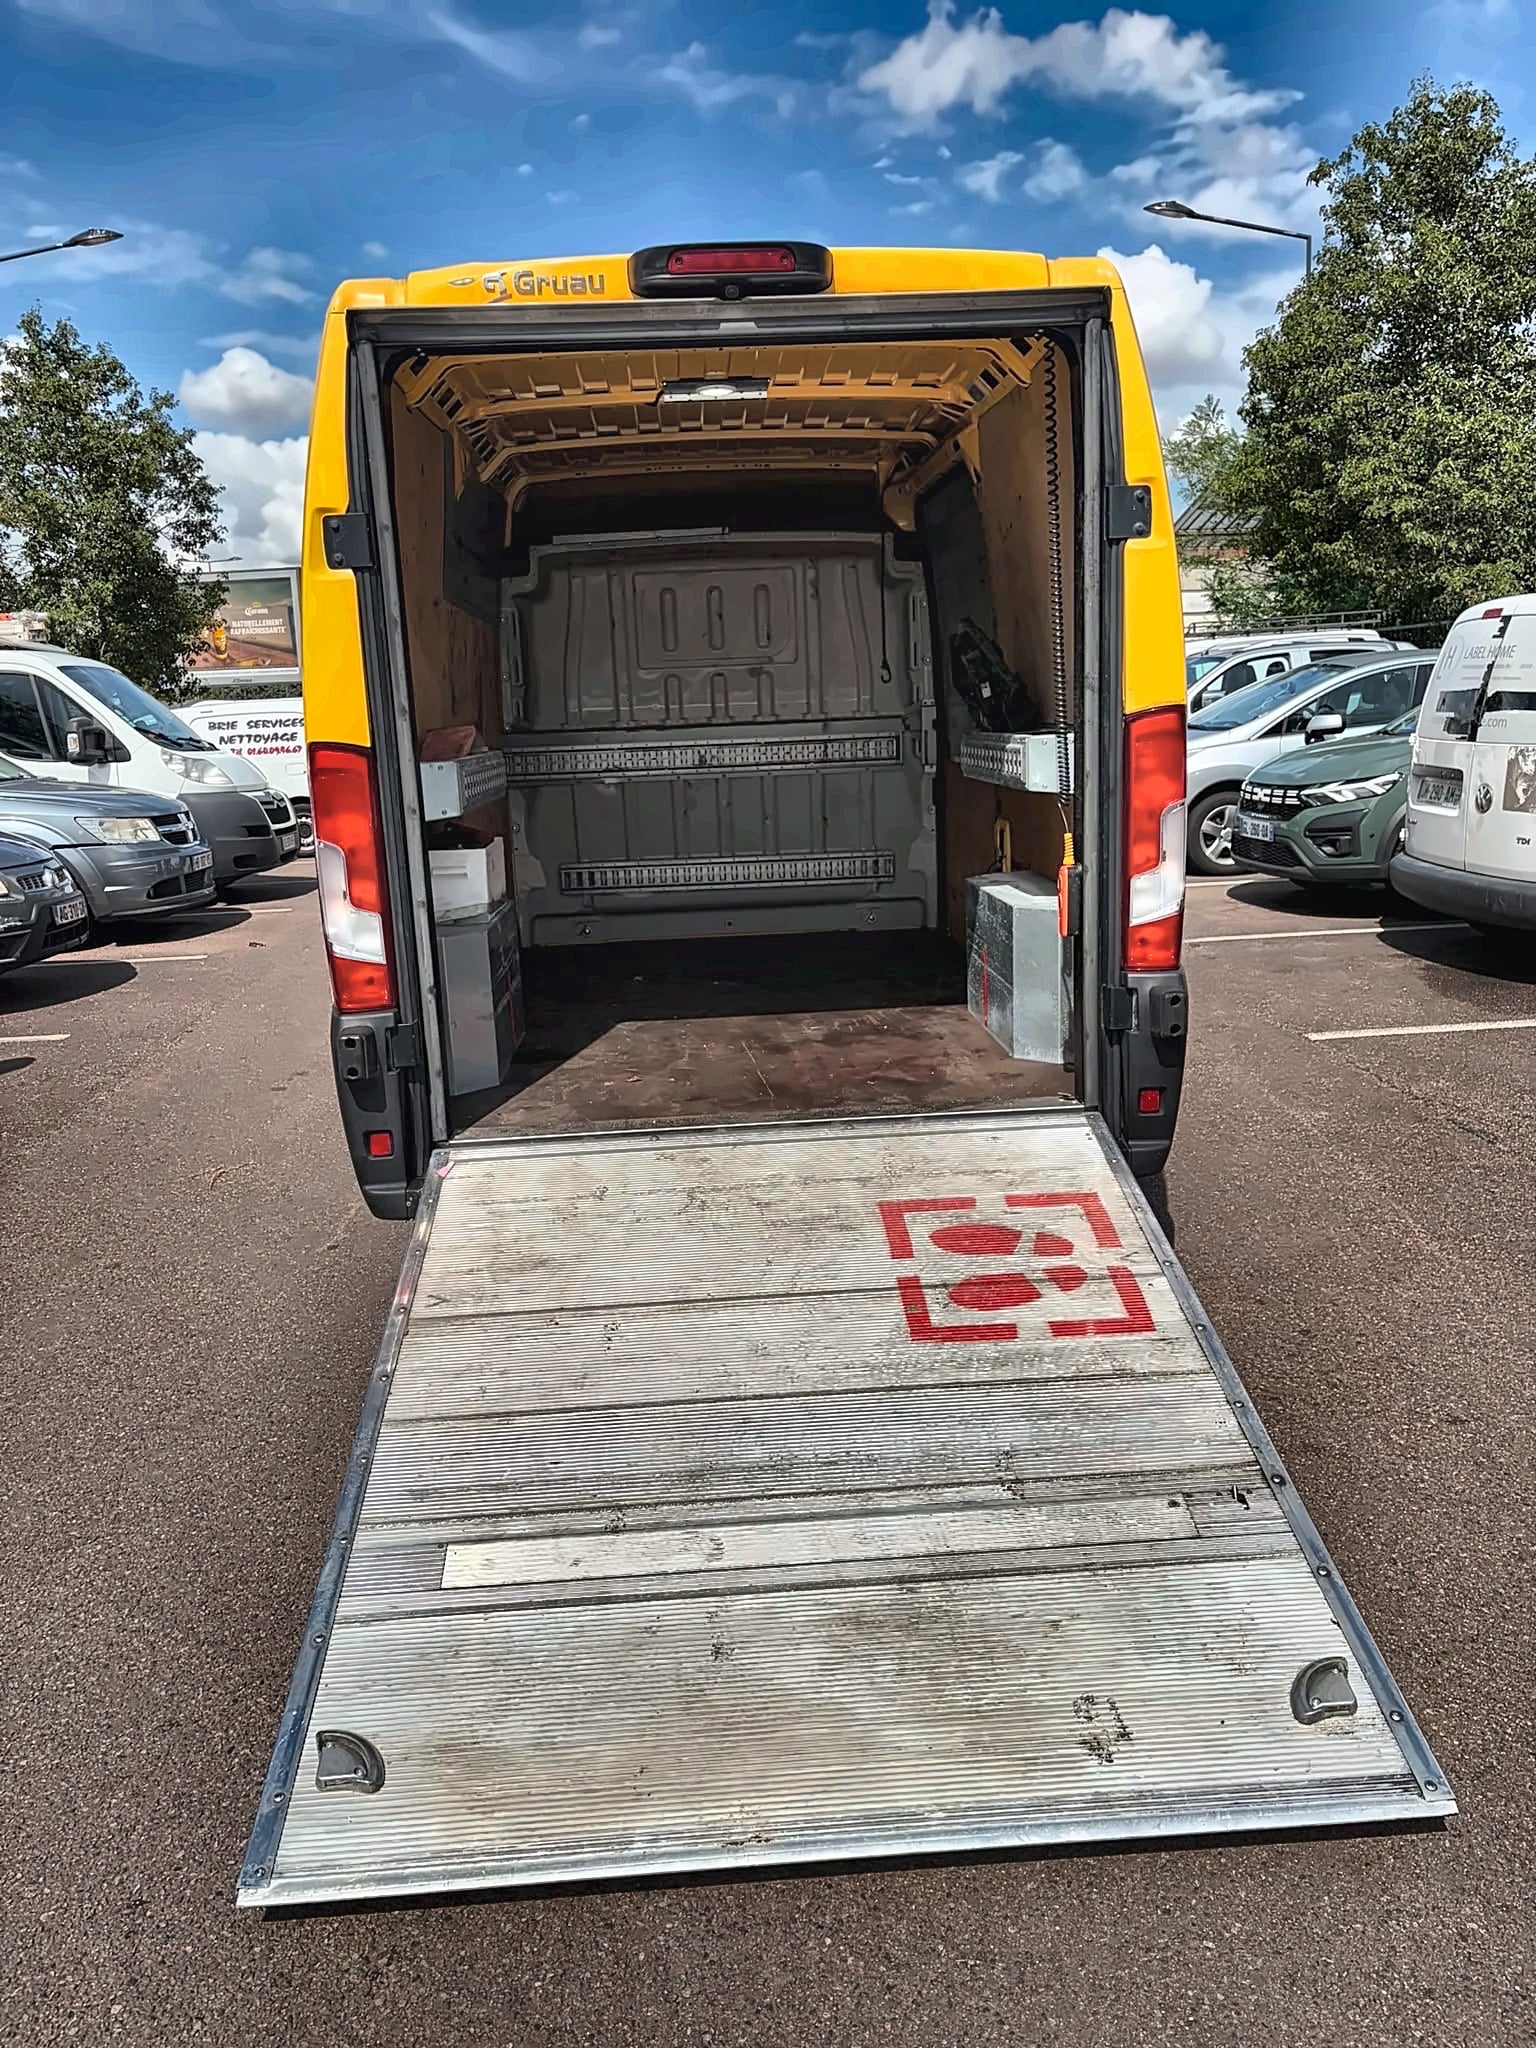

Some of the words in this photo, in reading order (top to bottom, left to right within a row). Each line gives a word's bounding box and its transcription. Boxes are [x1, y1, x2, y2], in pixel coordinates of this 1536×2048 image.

[514, 270, 605, 296] Gruau
[1464, 646, 1487, 659] LABEL
[1487, 644, 1517, 659] HOME
[208, 721, 238, 731] BRIE
[246, 718, 305, 729] SERVICES
[219, 732, 298, 745] NETTOYAGE
[1516, 837, 1531, 845] TDI
